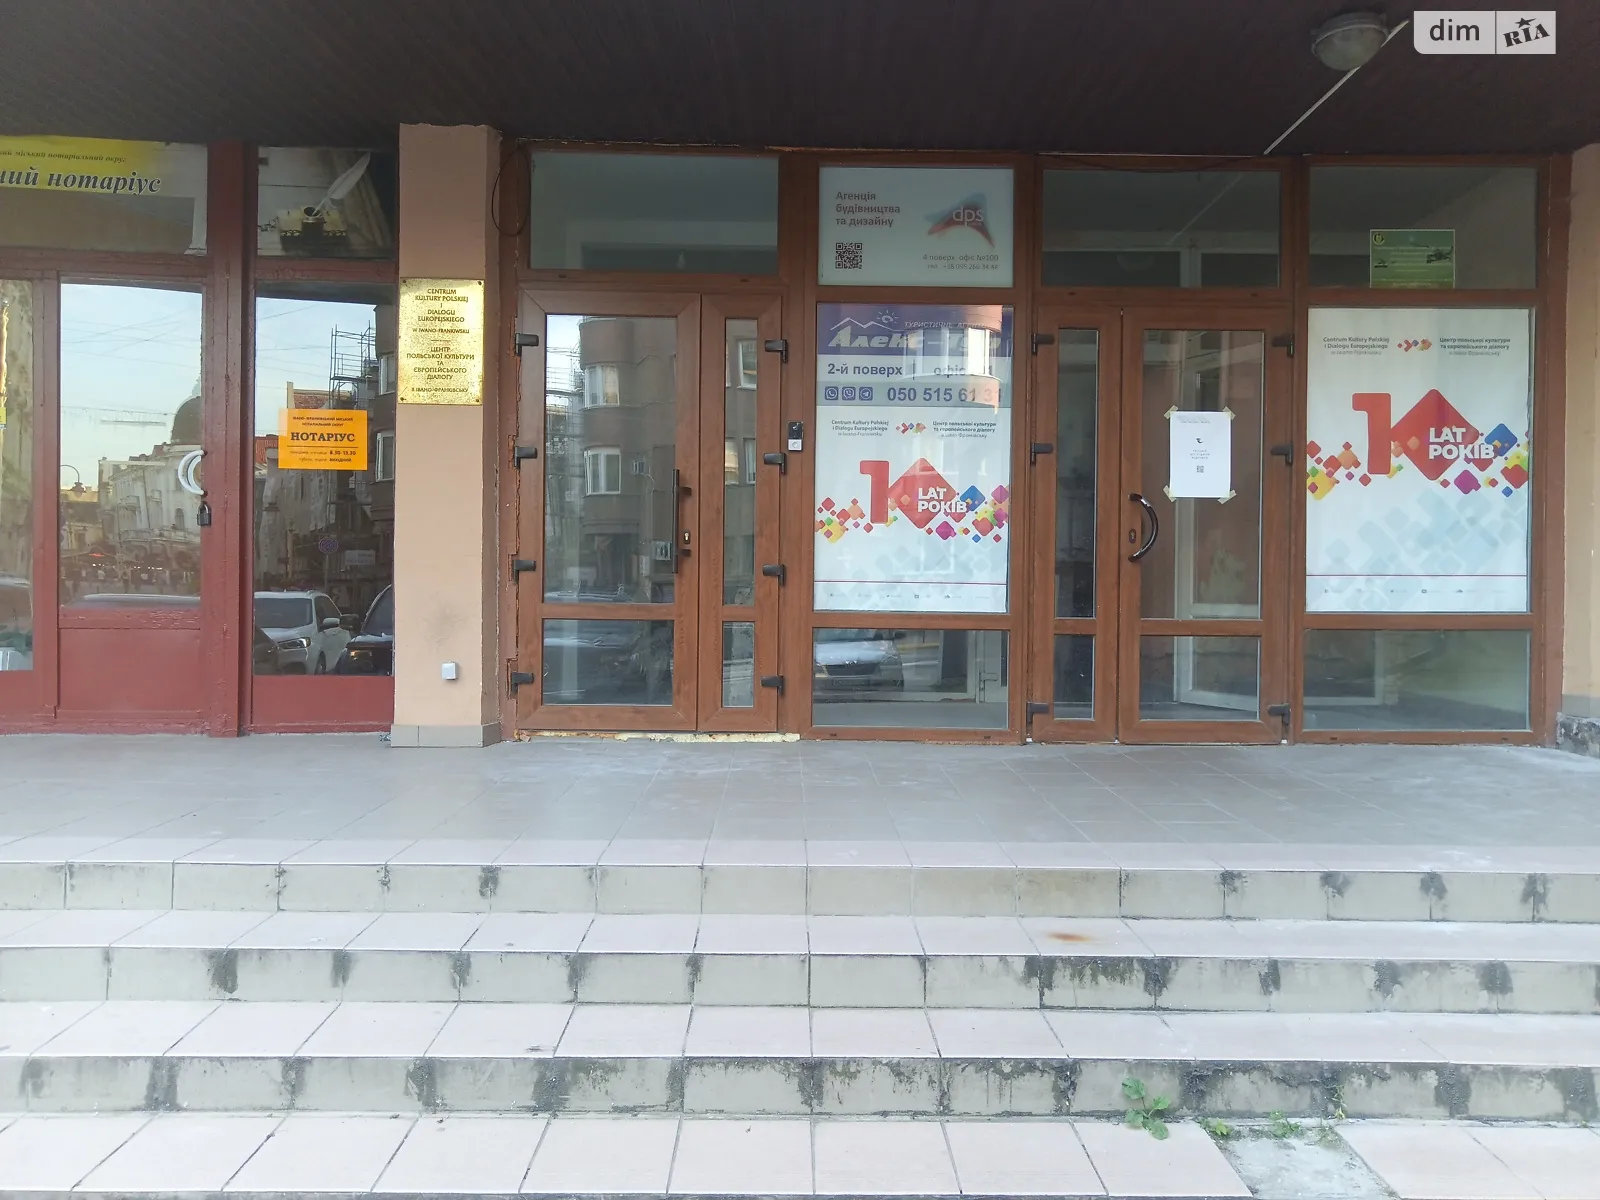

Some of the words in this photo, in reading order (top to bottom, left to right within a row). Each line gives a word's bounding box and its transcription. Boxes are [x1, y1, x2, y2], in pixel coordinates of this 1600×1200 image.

[48, 172, 160, 195] нотаріус
[836, 192, 876, 202] Агенція
[836, 204, 900, 214] будівництва
[849, 216, 894, 228] дизайну
[952, 206, 984, 226] dps
[827, 363, 848, 374] 2-й
[853, 365, 902, 377] поверх
[887, 388, 917, 401] 050
[923, 388, 952, 402] 515
[958, 388, 976, 402] 61
[291, 432, 355, 442] НОТАРІУС
[1429, 427, 1466, 443] LAT
[1428, 444, 1494, 460] РОКІВ
[918, 487, 947, 500] LAT
[918, 501, 967, 513] РОКІВ
